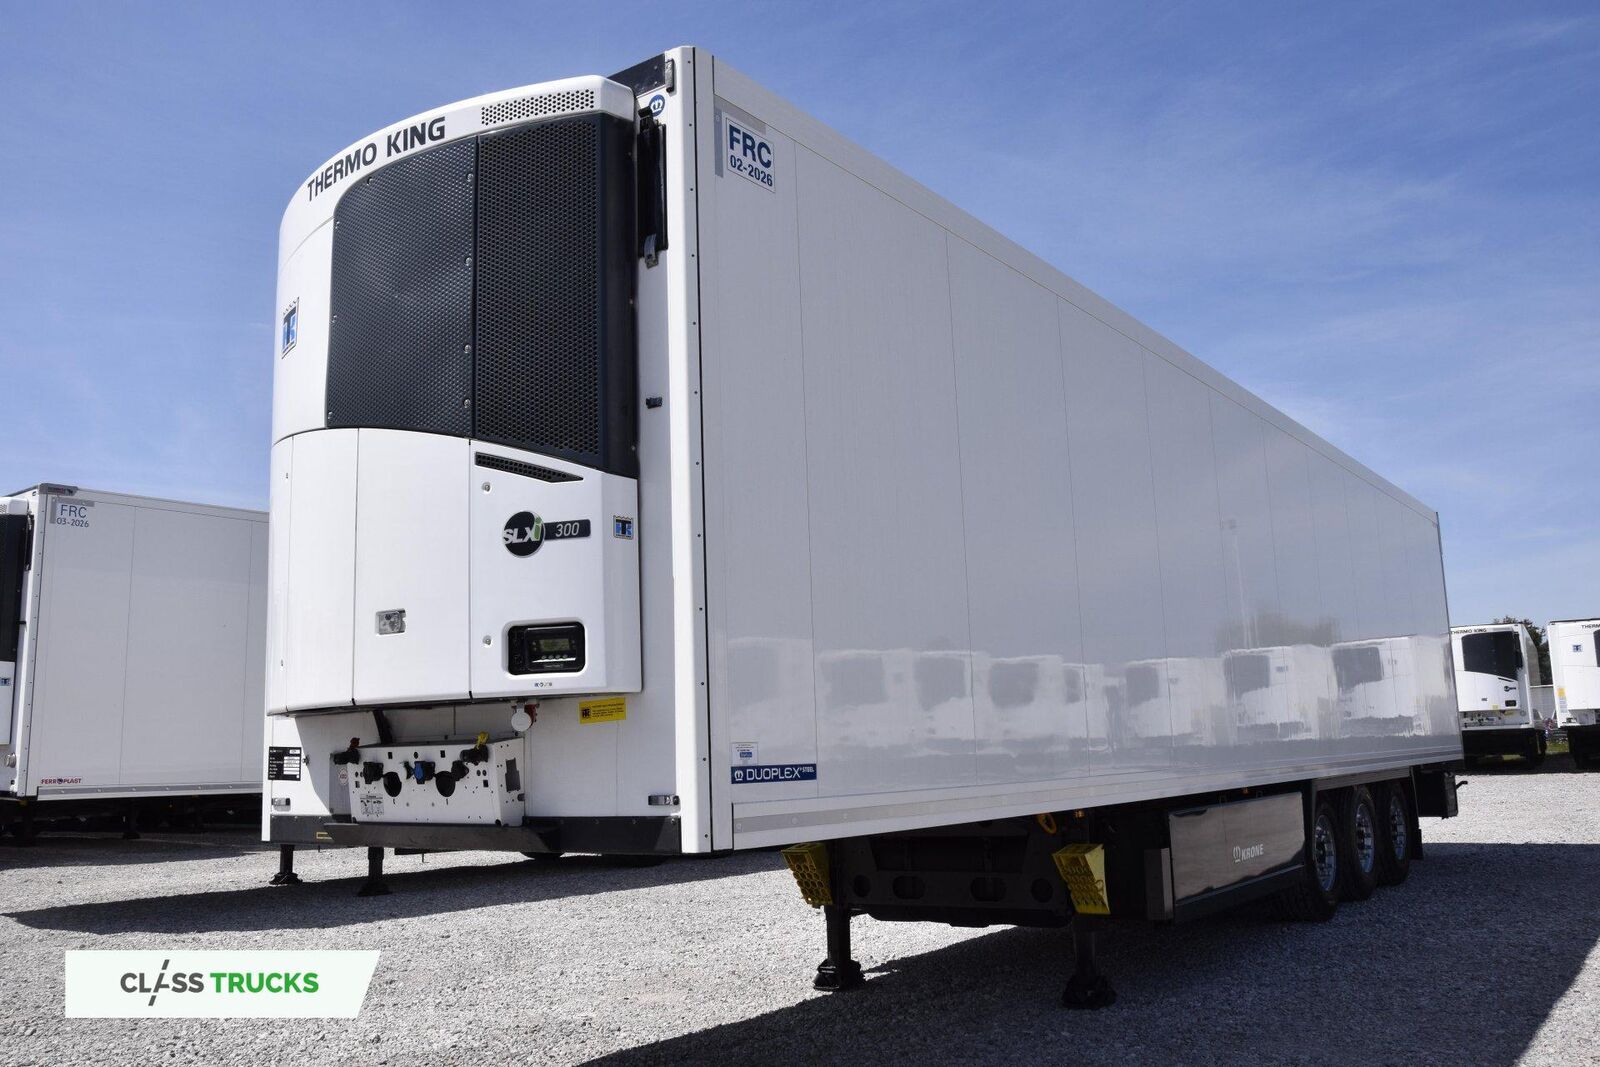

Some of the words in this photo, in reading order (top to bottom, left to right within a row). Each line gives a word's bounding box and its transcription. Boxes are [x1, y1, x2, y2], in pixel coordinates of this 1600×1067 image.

[728, 123, 772, 169] FRC
[307, 142, 377, 202] THERMO
[386, 116, 446, 158] KING
[729, 154, 773, 187] 02-2026
[60, 504, 87, 519] FRC
[56, 517, 90, 528] 03-2026
[555, 522, 580, 537] 300
[746, 767, 800, 780] DUOPLEX
[1241, 843, 1264, 861] KRONE
